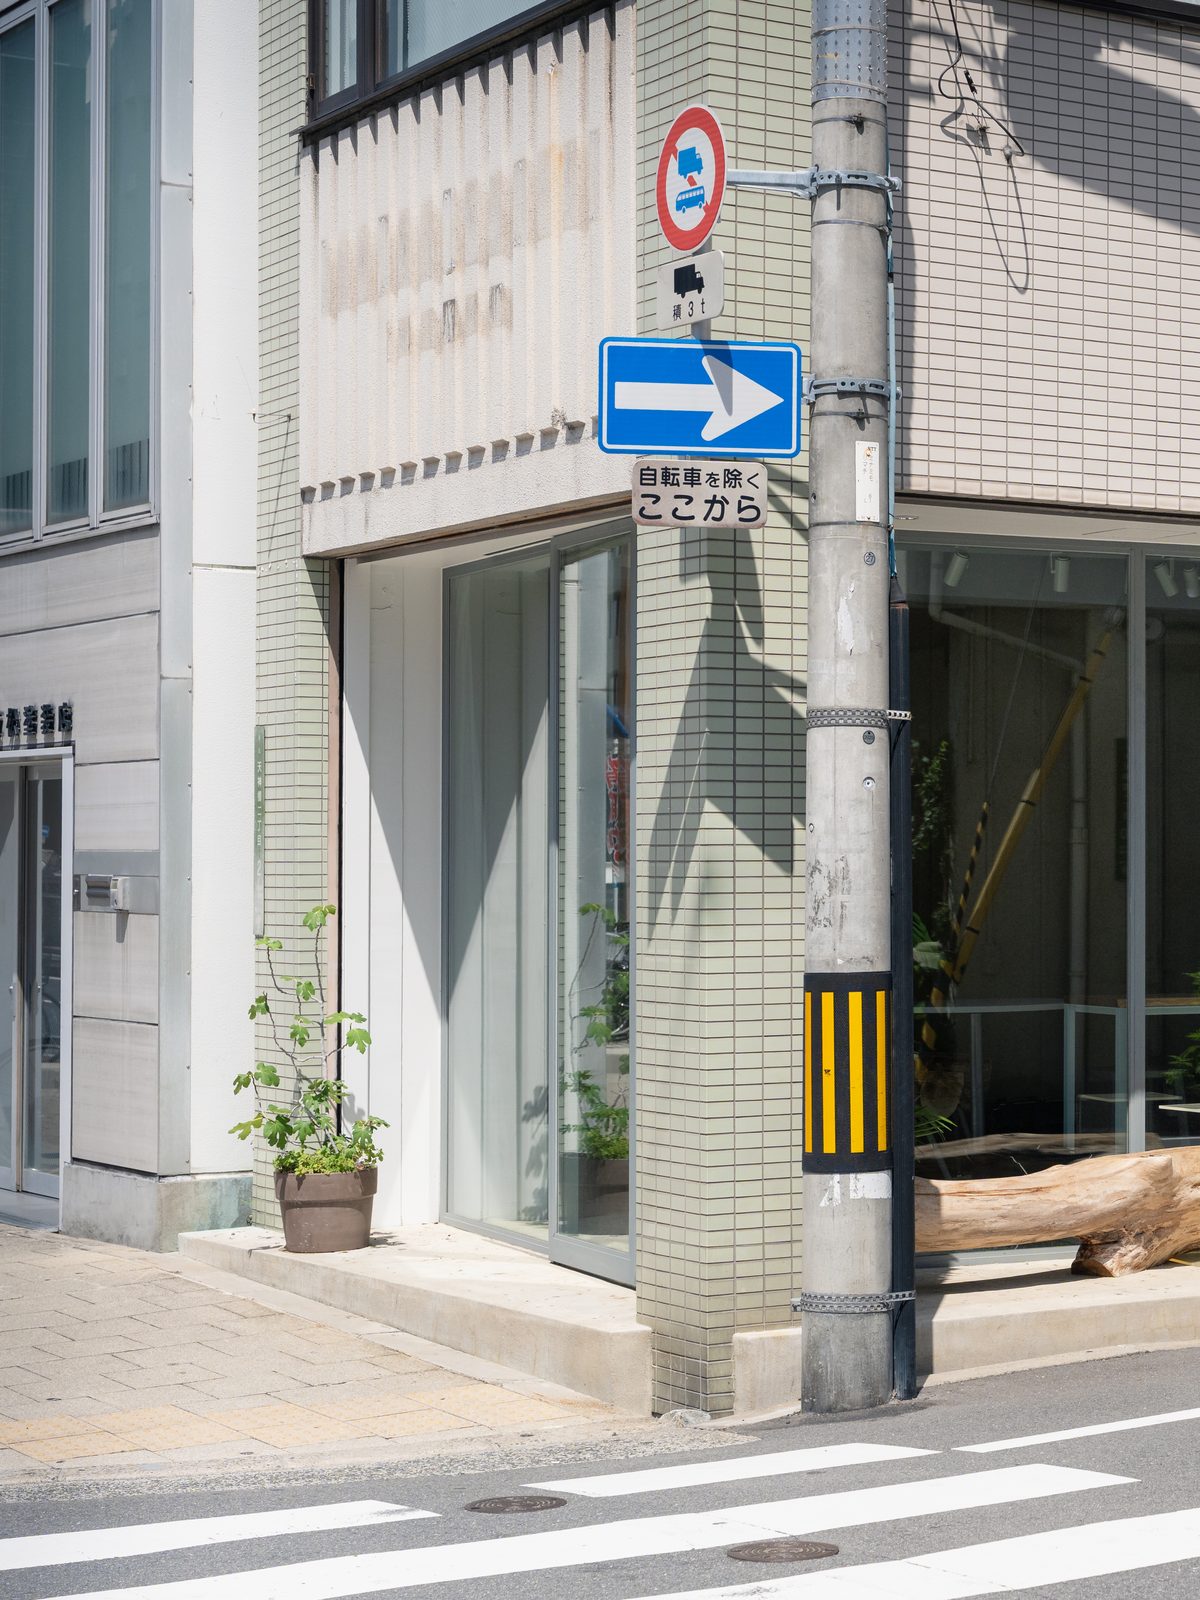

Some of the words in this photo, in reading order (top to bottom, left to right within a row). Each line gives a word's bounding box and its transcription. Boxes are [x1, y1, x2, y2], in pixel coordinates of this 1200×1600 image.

[638, 466, 761, 489] 自転車を除く
[638, 493, 762, 523] ここから
[865, 555, 874, 563] 27
